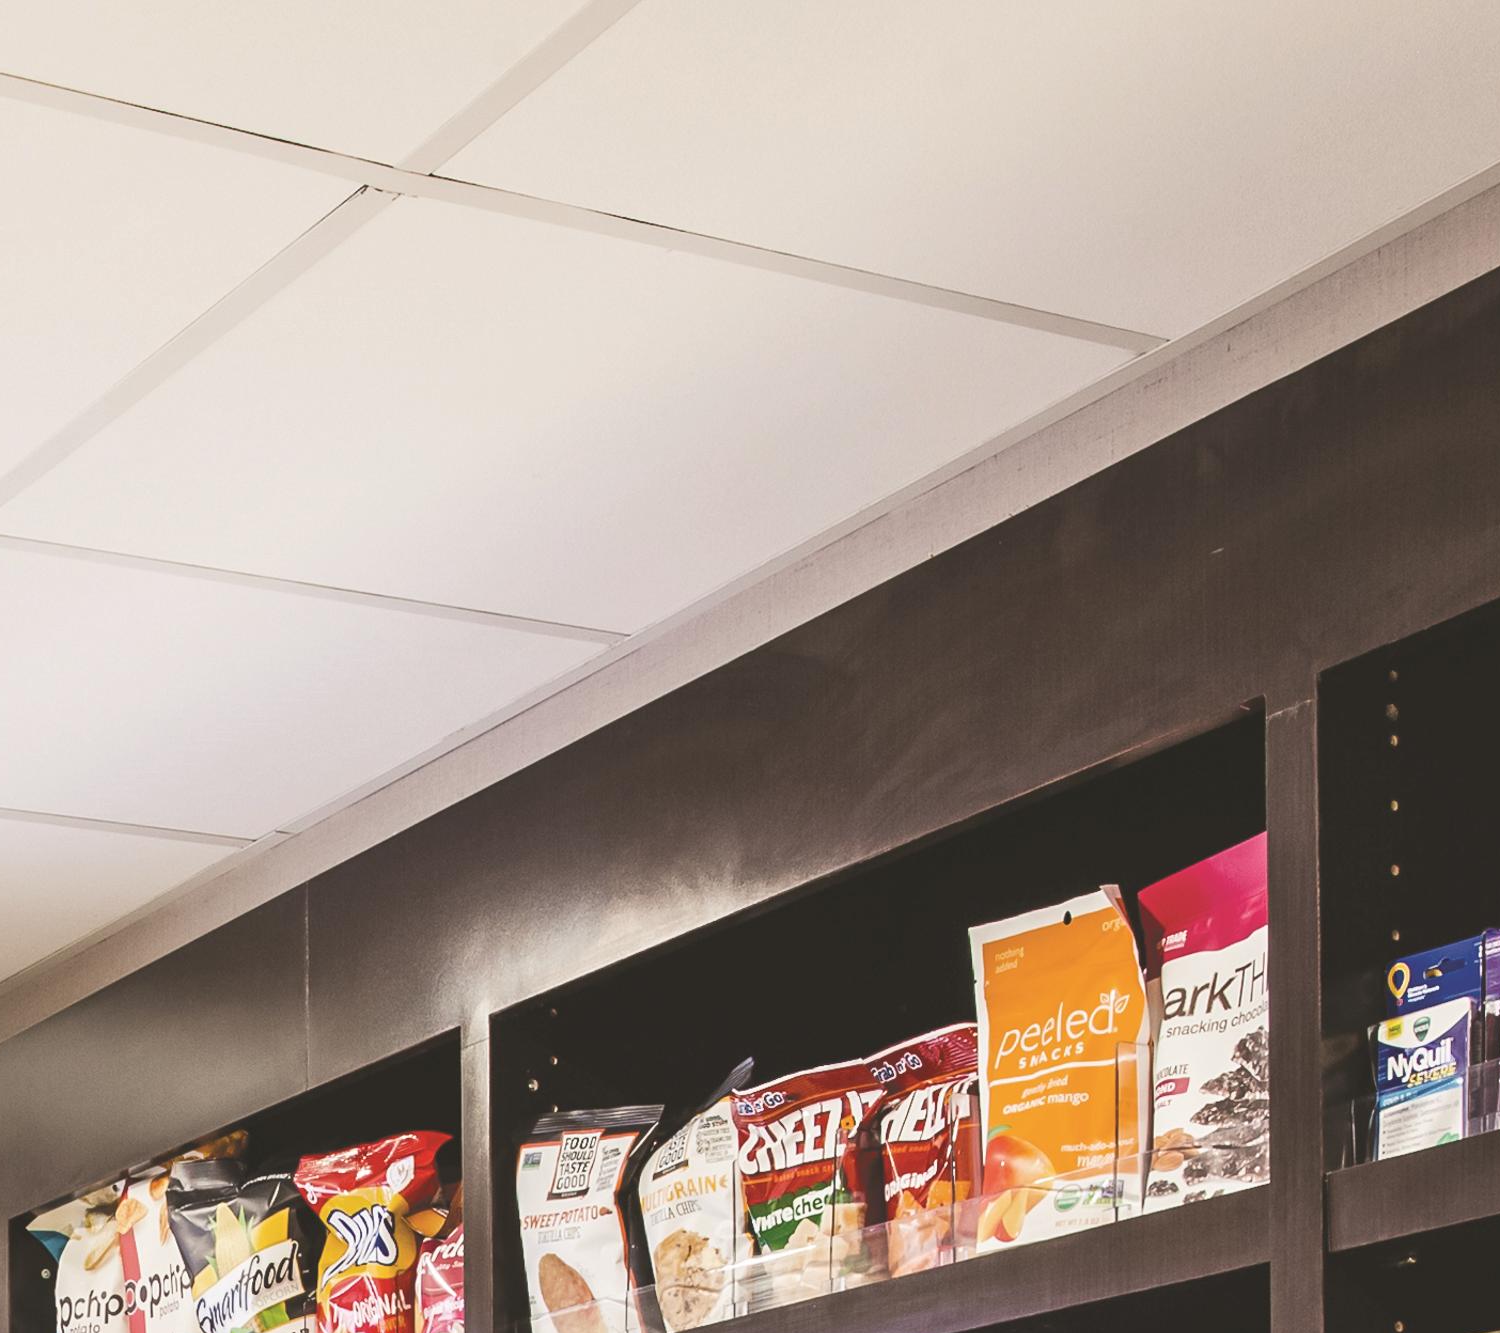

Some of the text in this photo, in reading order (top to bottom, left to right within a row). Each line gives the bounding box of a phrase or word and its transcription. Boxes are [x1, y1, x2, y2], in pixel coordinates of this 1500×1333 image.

[995, 992, 1118, 1070] peeled
[1019, 1041, 1085, 1069] SNACKS
[1387, 1037, 1454, 1083] NyQuil
[1407, 1062, 1456, 1088] SEVERE
[1003, 1091, 1089, 1115] ORGANIC mango
[564, 1136, 597, 1151] FOOD
[560, 1162, 590, 1177] TASTE
[561, 1149, 594, 1167] SHOULD
[557, 1174, 585, 1191] GOOD
[524, 1205, 599, 1231] SWEET POTATO
